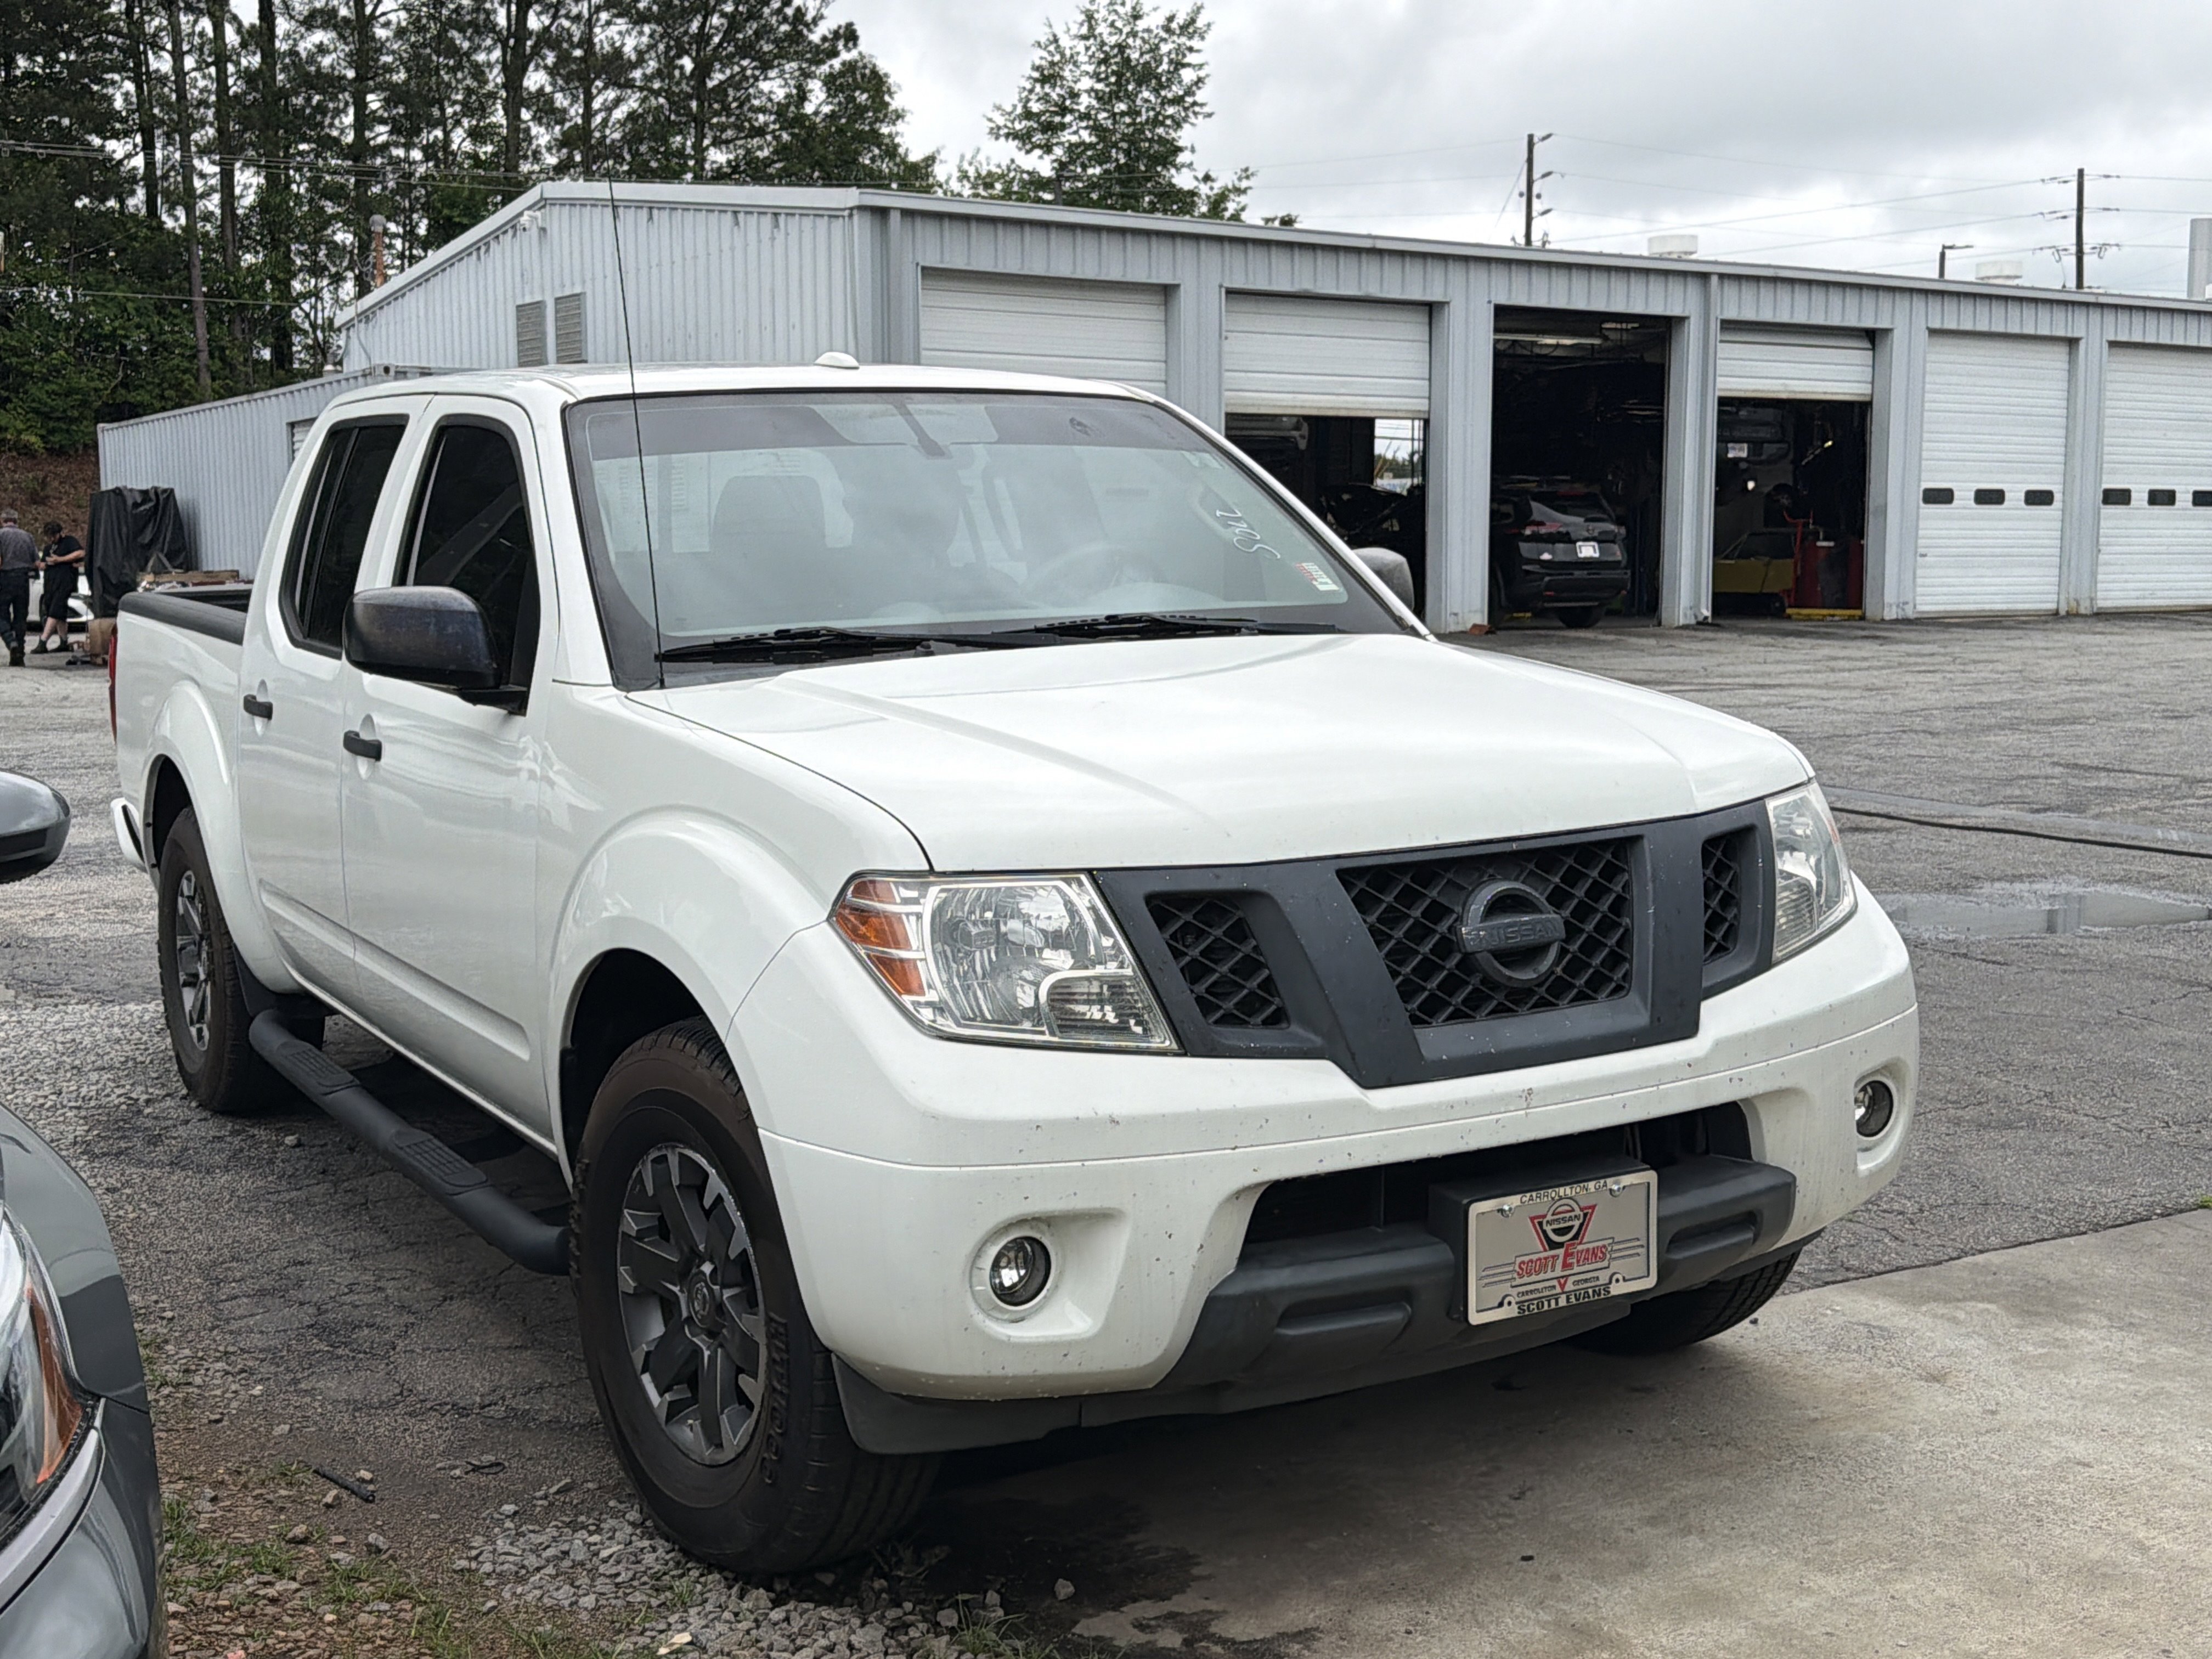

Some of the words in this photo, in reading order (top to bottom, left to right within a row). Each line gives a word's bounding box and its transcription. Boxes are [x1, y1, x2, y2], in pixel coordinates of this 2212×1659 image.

[1480, 921, 1560, 946] NISSAN
[1595, 1180, 1608, 1190] GA
[1545, 1215, 1581, 1227] NISSAN
[1517, 1254, 1559, 1278] SCOTT
[1561, 1242, 1608, 1271] EVANS
[1572, 1277, 1600, 1287] GEORGIA
[1517, 1296, 1561, 1315] SCOTT
[1566, 1286, 1611, 1305] EVANS
